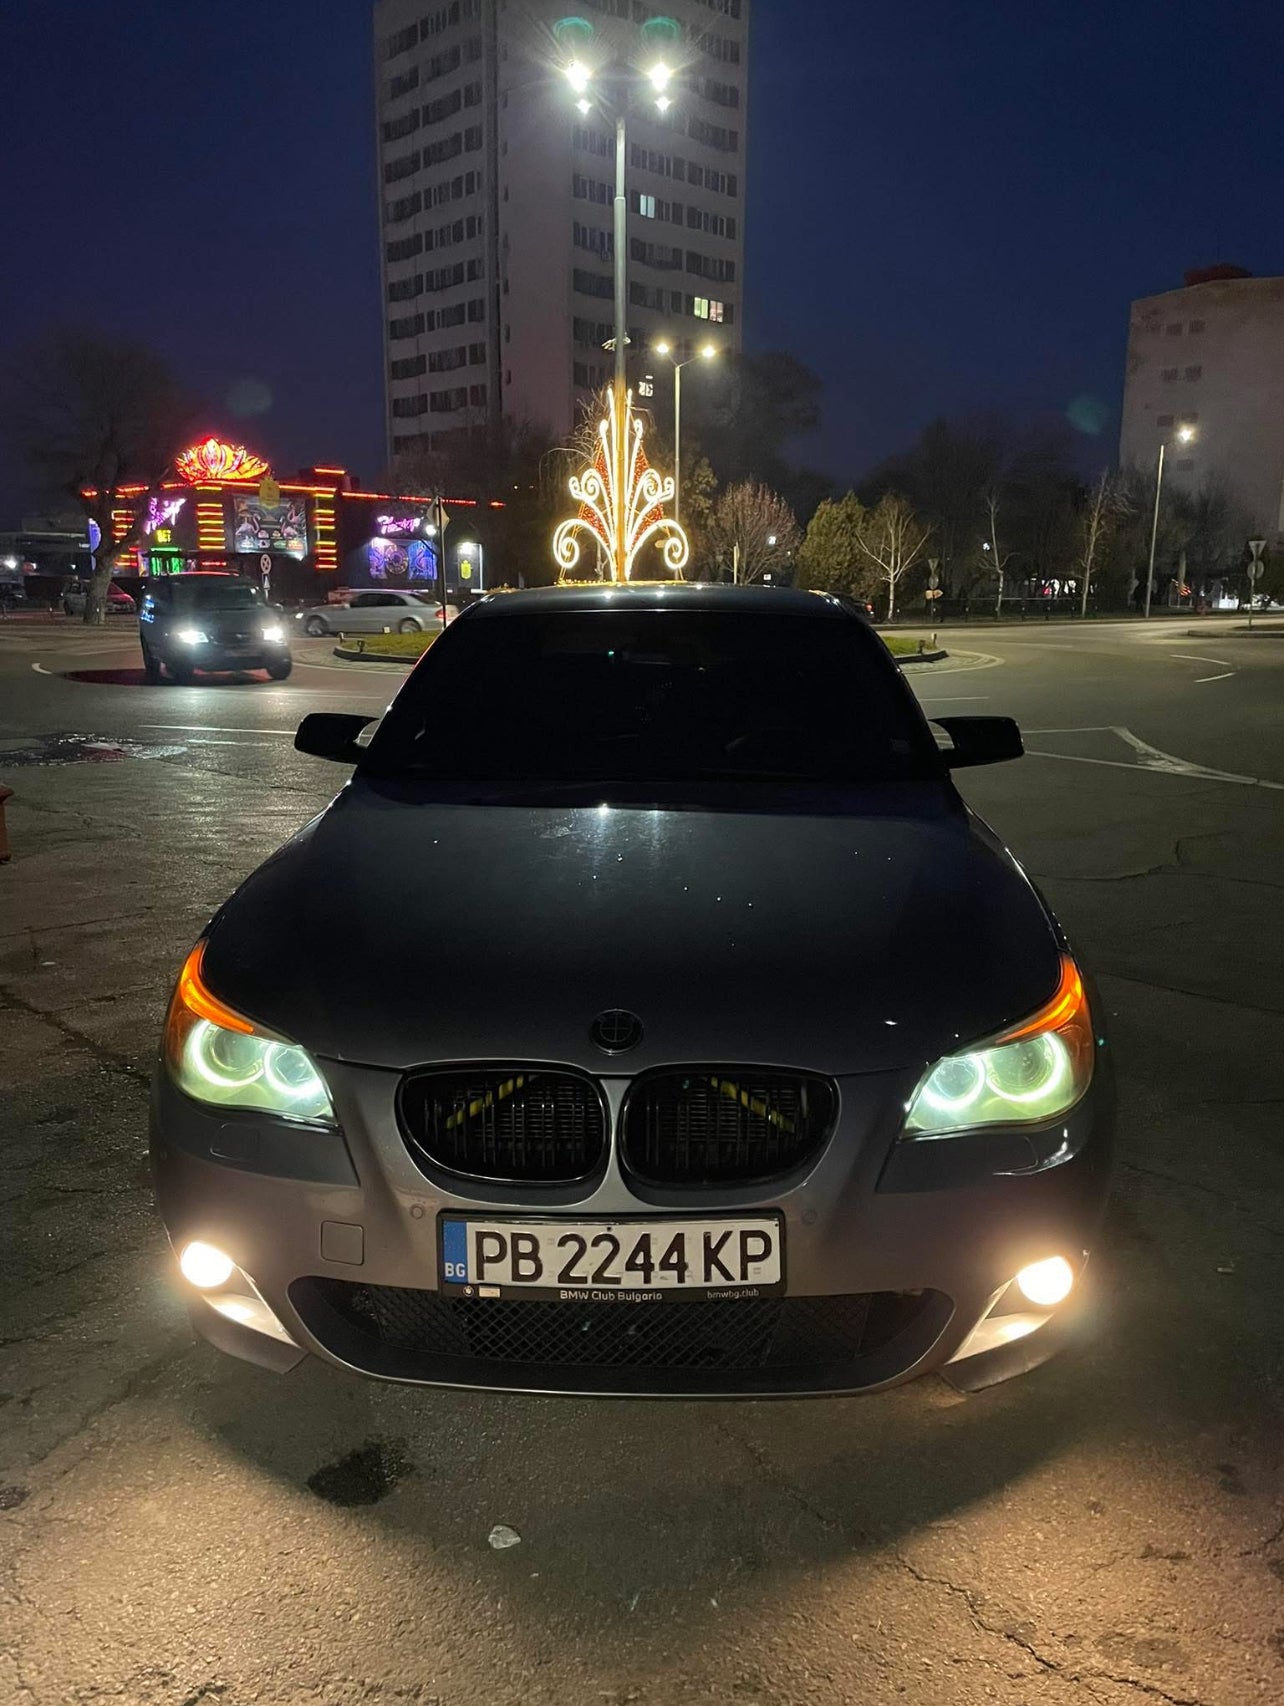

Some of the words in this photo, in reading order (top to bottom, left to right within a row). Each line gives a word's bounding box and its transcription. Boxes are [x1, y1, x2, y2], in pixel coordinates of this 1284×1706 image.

[475, 1230, 543, 1283] PB
[557, 1231, 689, 1285] 2244
[703, 1229, 773, 1283] KP
[444, 1262, 466, 1277] BG
[560, 1290, 589, 1300] BMW
[591, 1290, 615, 1301] Club
[617, 1291, 663, 1303] Bulgaria
